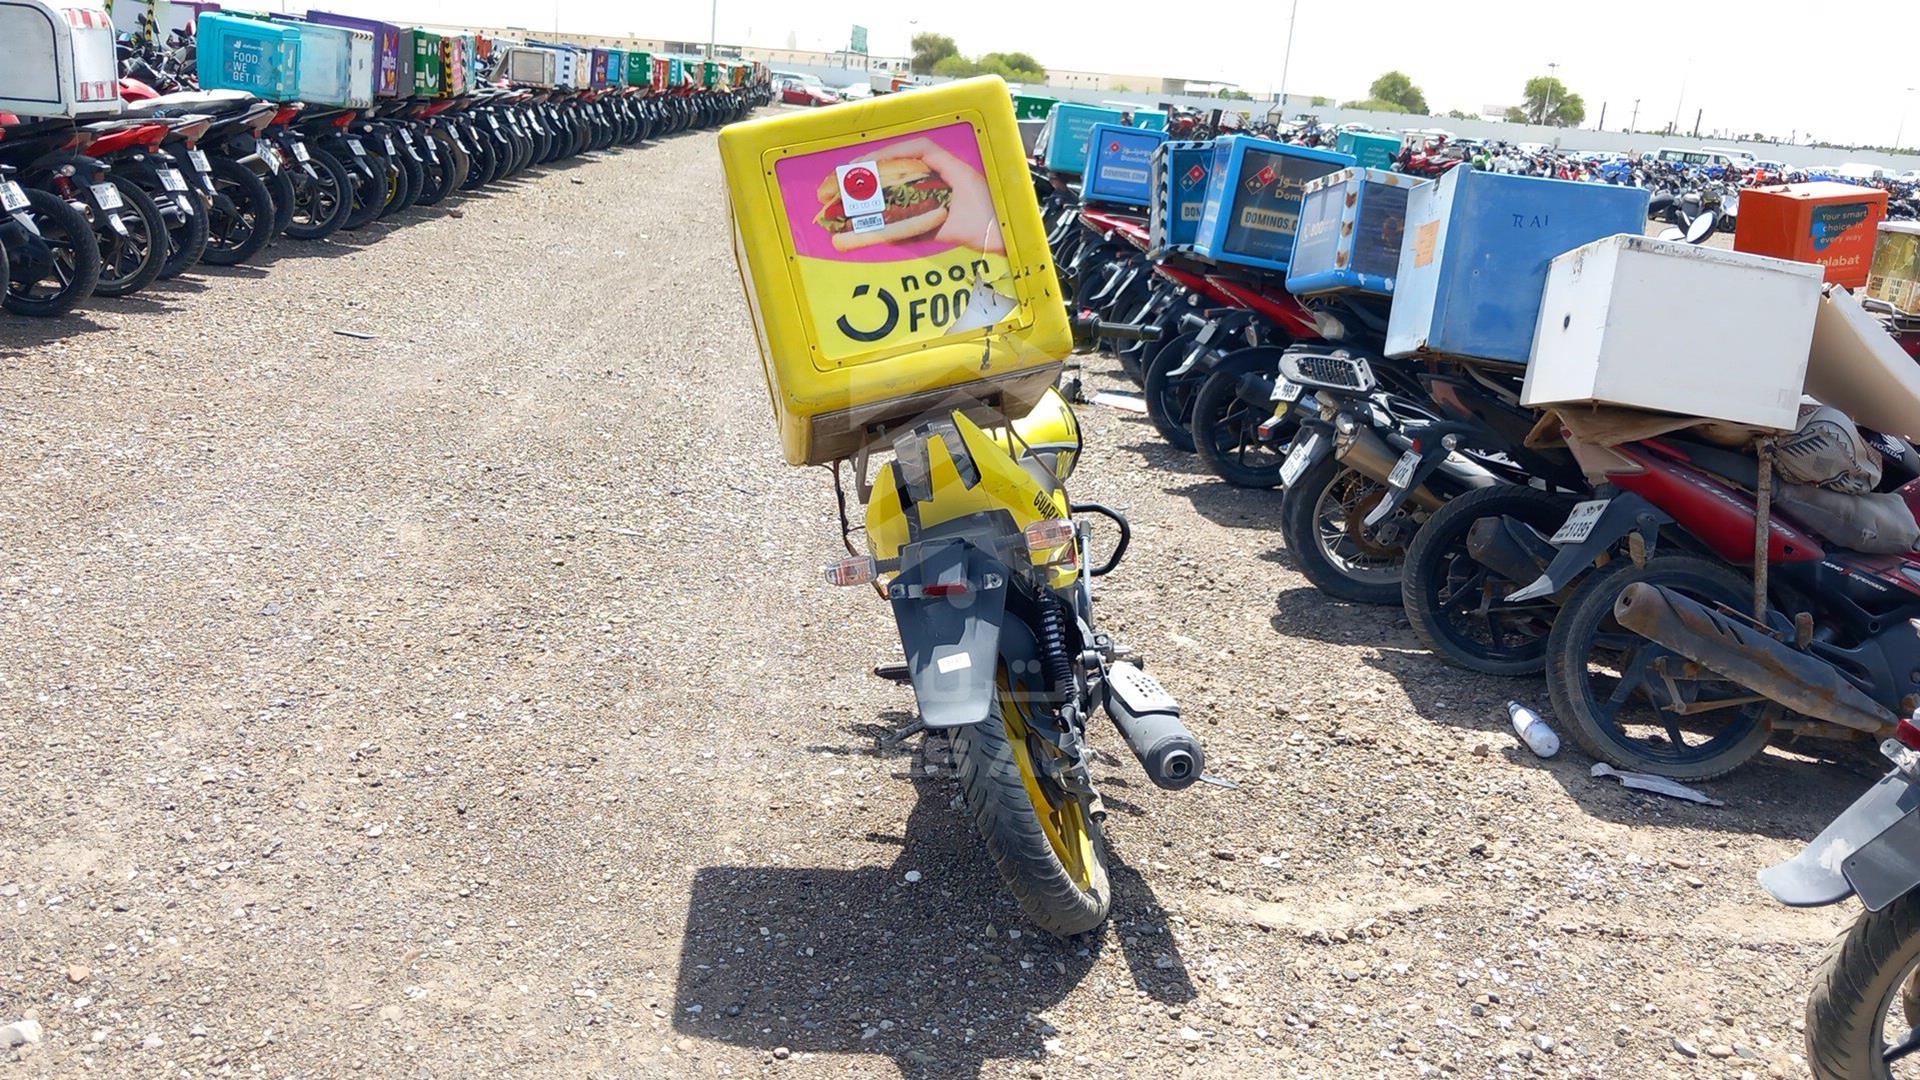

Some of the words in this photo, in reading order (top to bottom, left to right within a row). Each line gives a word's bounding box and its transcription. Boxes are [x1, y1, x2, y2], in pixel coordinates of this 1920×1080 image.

[233, 61, 248, 73] WE
[233, 71, 250, 82] GET
[253, 74, 261, 84] IT
[1822, 212, 1840, 220] Your
[1842, 210, 1867, 219] smart
[1816, 254, 1860, 267] talabat
[901, 259, 990, 292] noon
[909, 284, 992, 332] FOO
